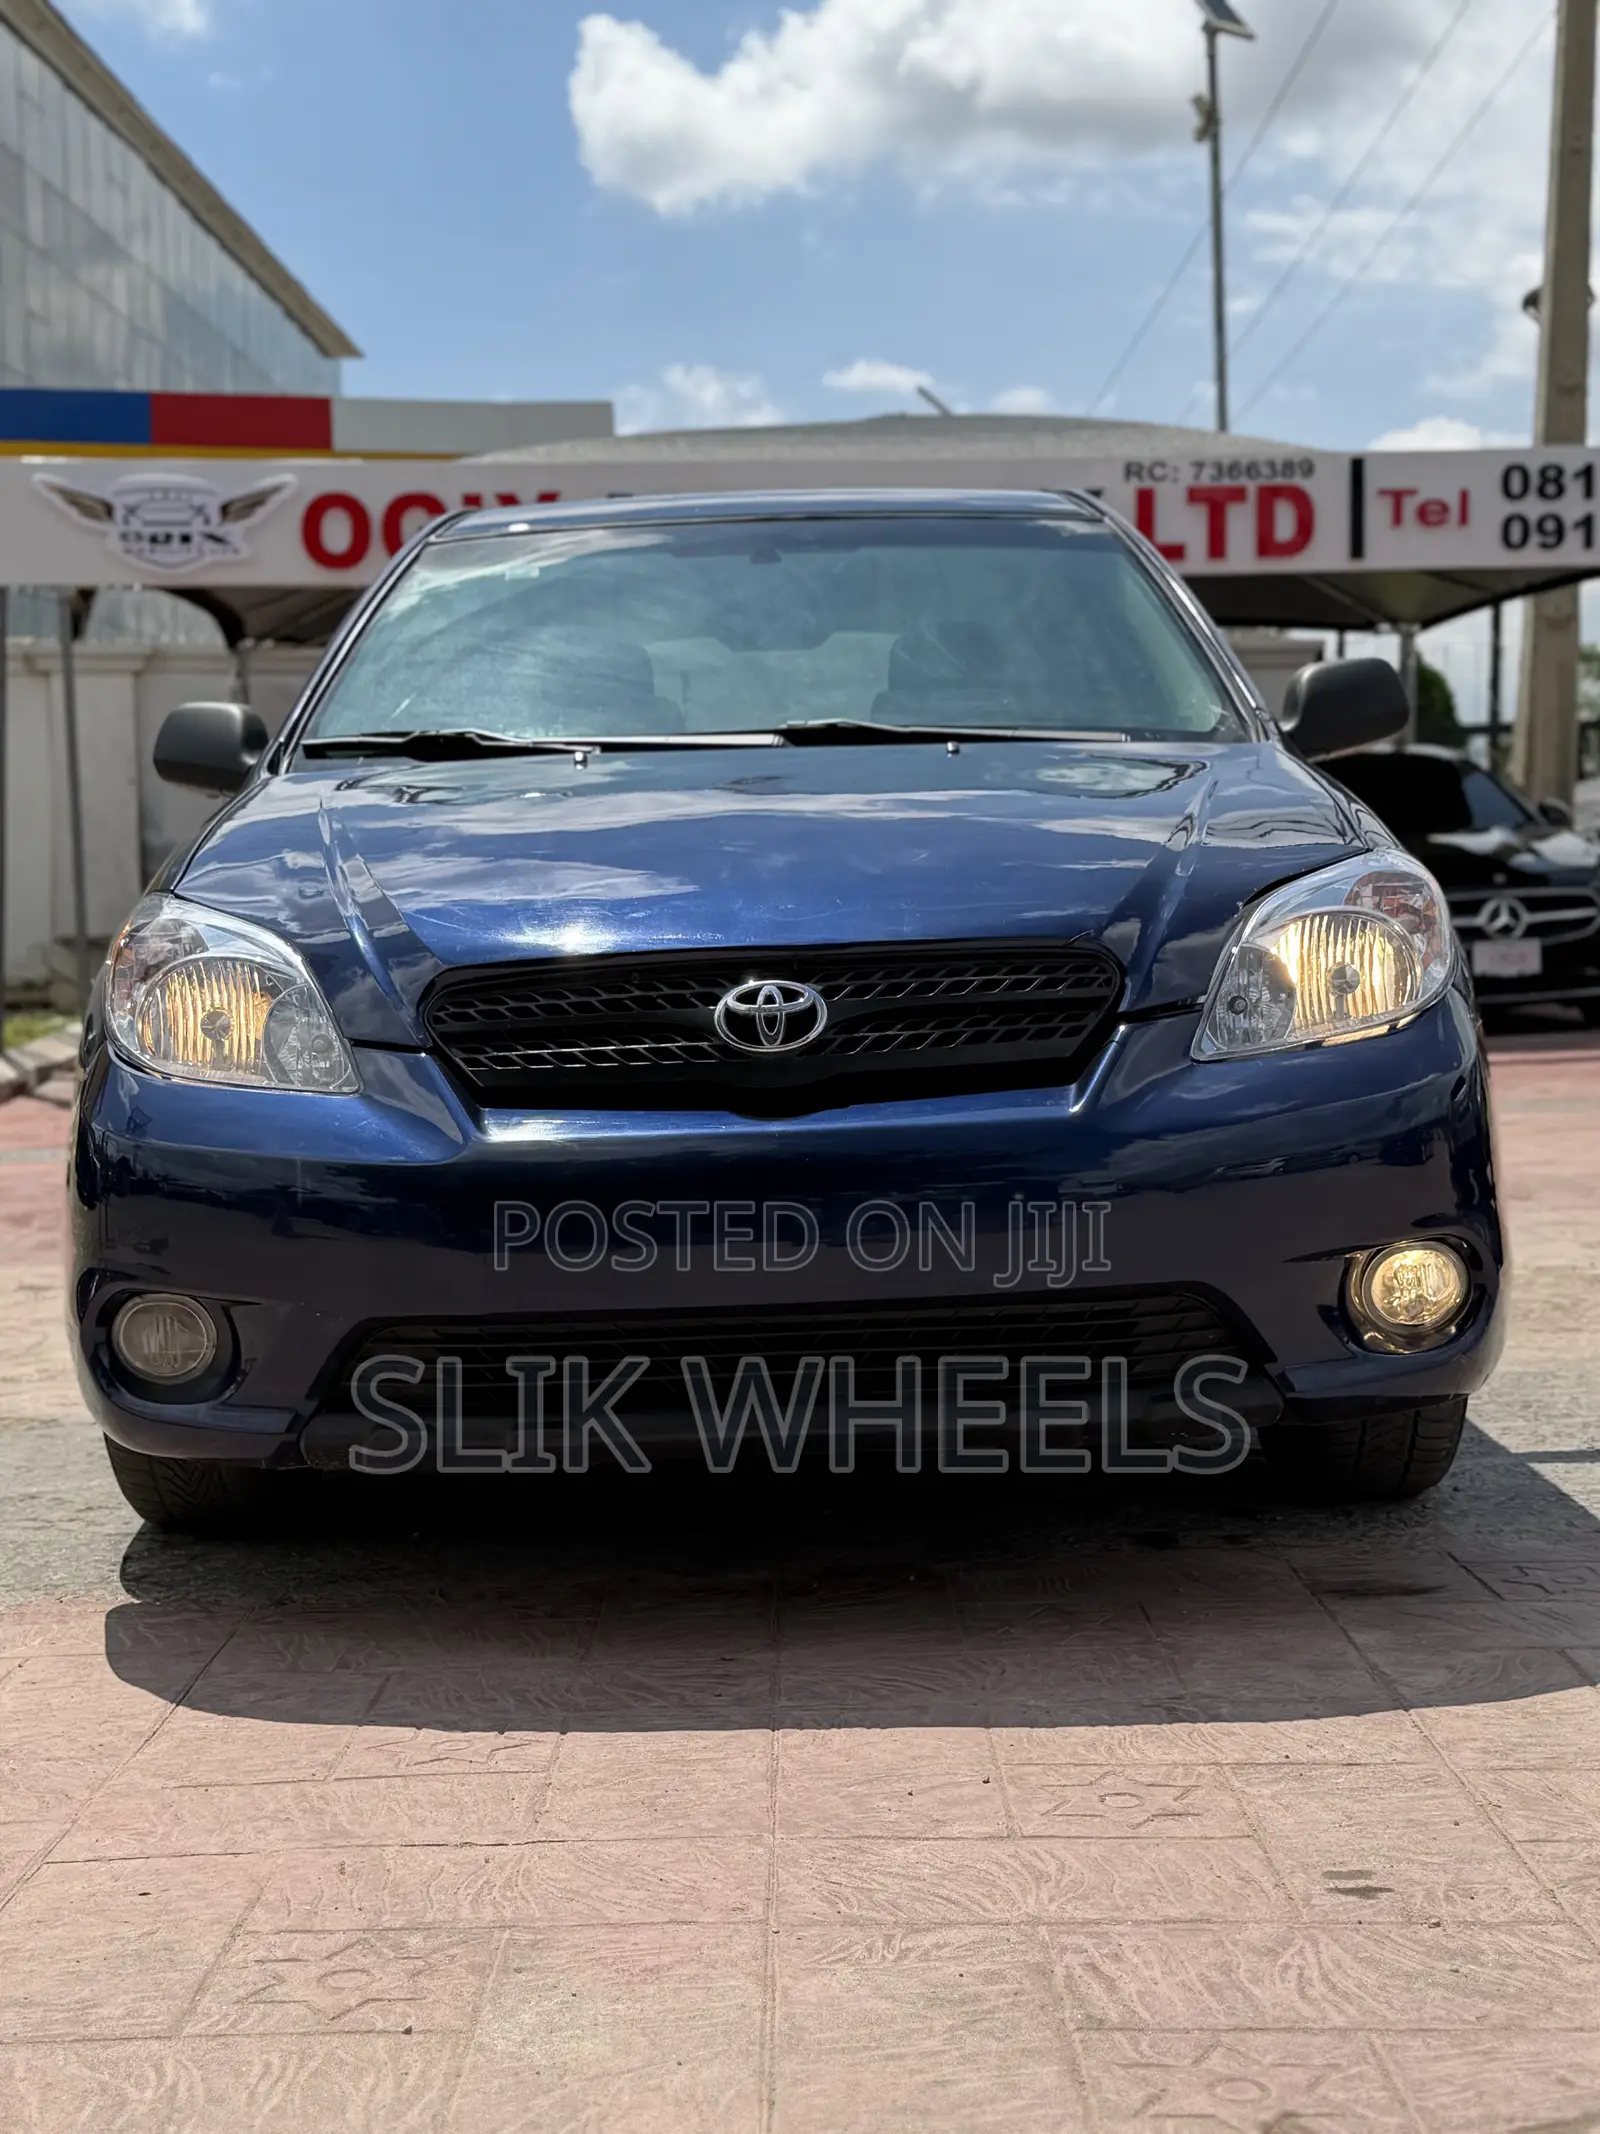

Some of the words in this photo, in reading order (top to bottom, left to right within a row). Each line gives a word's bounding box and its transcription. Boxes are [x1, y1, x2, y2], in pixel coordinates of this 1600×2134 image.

[1123, 460, 1180, 483] RC:
[1189, 458, 1315, 482] 7366389
[1501, 462, 1595, 501] 081
[1135, 484, 1316, 560] LTD
[1377, 487, 1470, 529] Tel
[1501, 512, 1595, 551] 091
